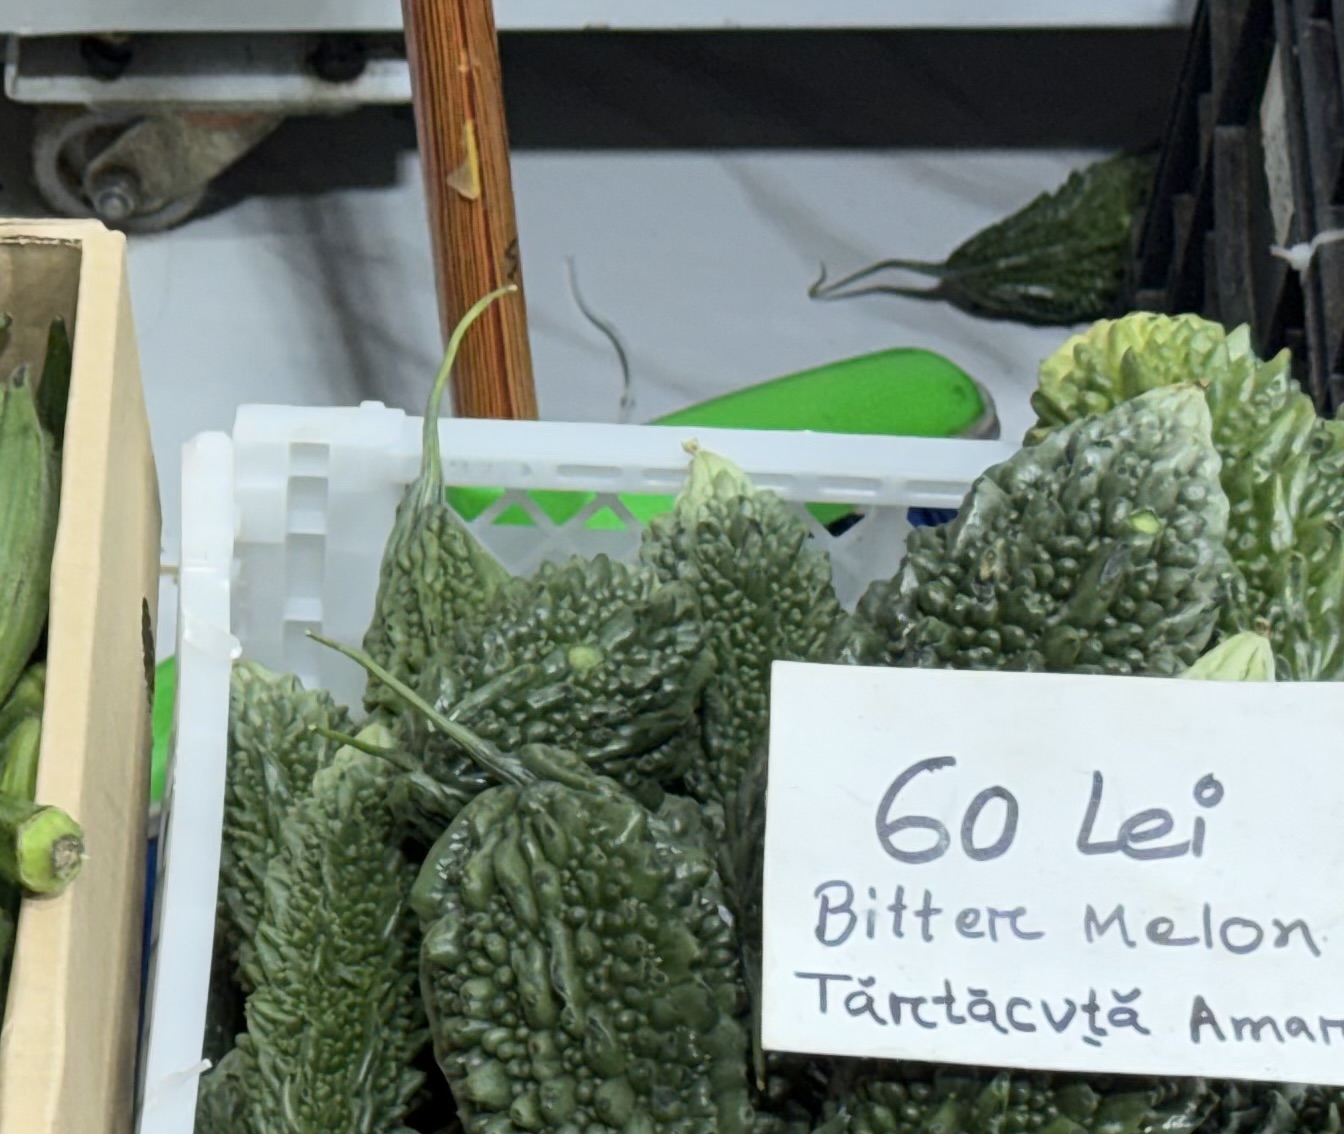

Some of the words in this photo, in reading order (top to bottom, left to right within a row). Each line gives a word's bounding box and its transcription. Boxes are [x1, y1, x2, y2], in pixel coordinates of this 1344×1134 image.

[875, 756, 1019, 865] 60
[1076, 770, 1225, 860] Lei
[1084, 903, 1321, 957] Melon
